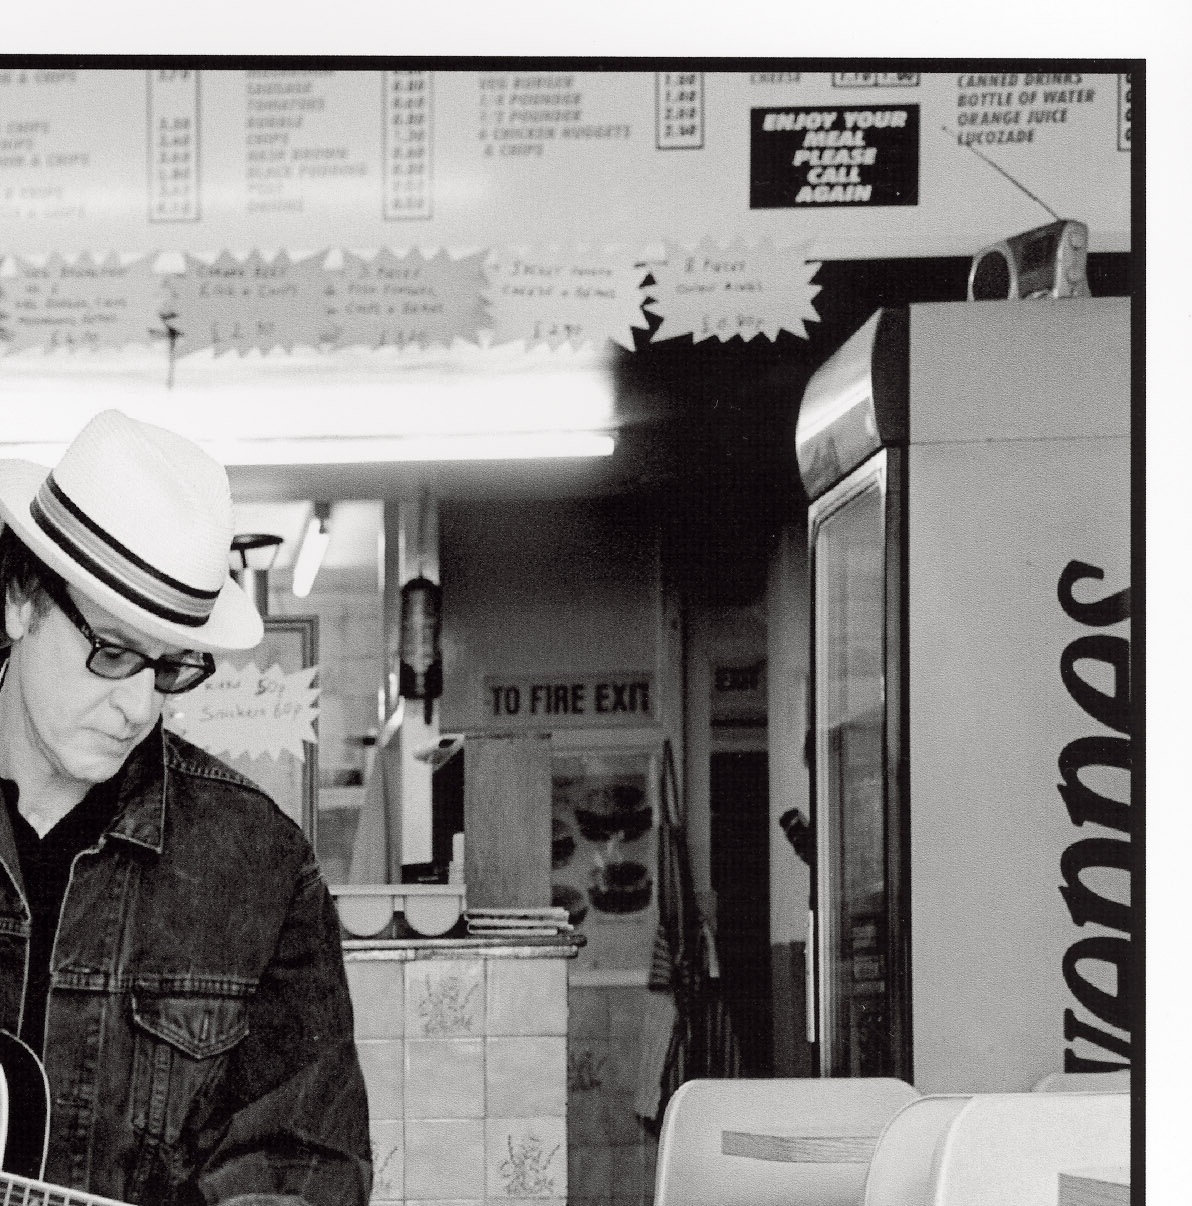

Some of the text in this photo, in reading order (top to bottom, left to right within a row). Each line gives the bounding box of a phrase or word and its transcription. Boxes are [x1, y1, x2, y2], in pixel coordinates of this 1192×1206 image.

[958, 73, 1083, 87] CANNED DRINKS
[958, 89, 1096, 107] BOTTLE OF WATER
[763, 110, 908, 131] ENJOY YOUR
[958, 108, 1068, 126] ORANGE JUICE
[802, 130, 866, 148] MEAL
[958, 129, 1034, 146] LUCOZADE
[792, 147, 878, 167] PLEASE
[807, 166, 862, 185] CALL
[794, 184, 873, 204] AGAIN
[489, 681, 650, 716] TO FIRE EXIT
